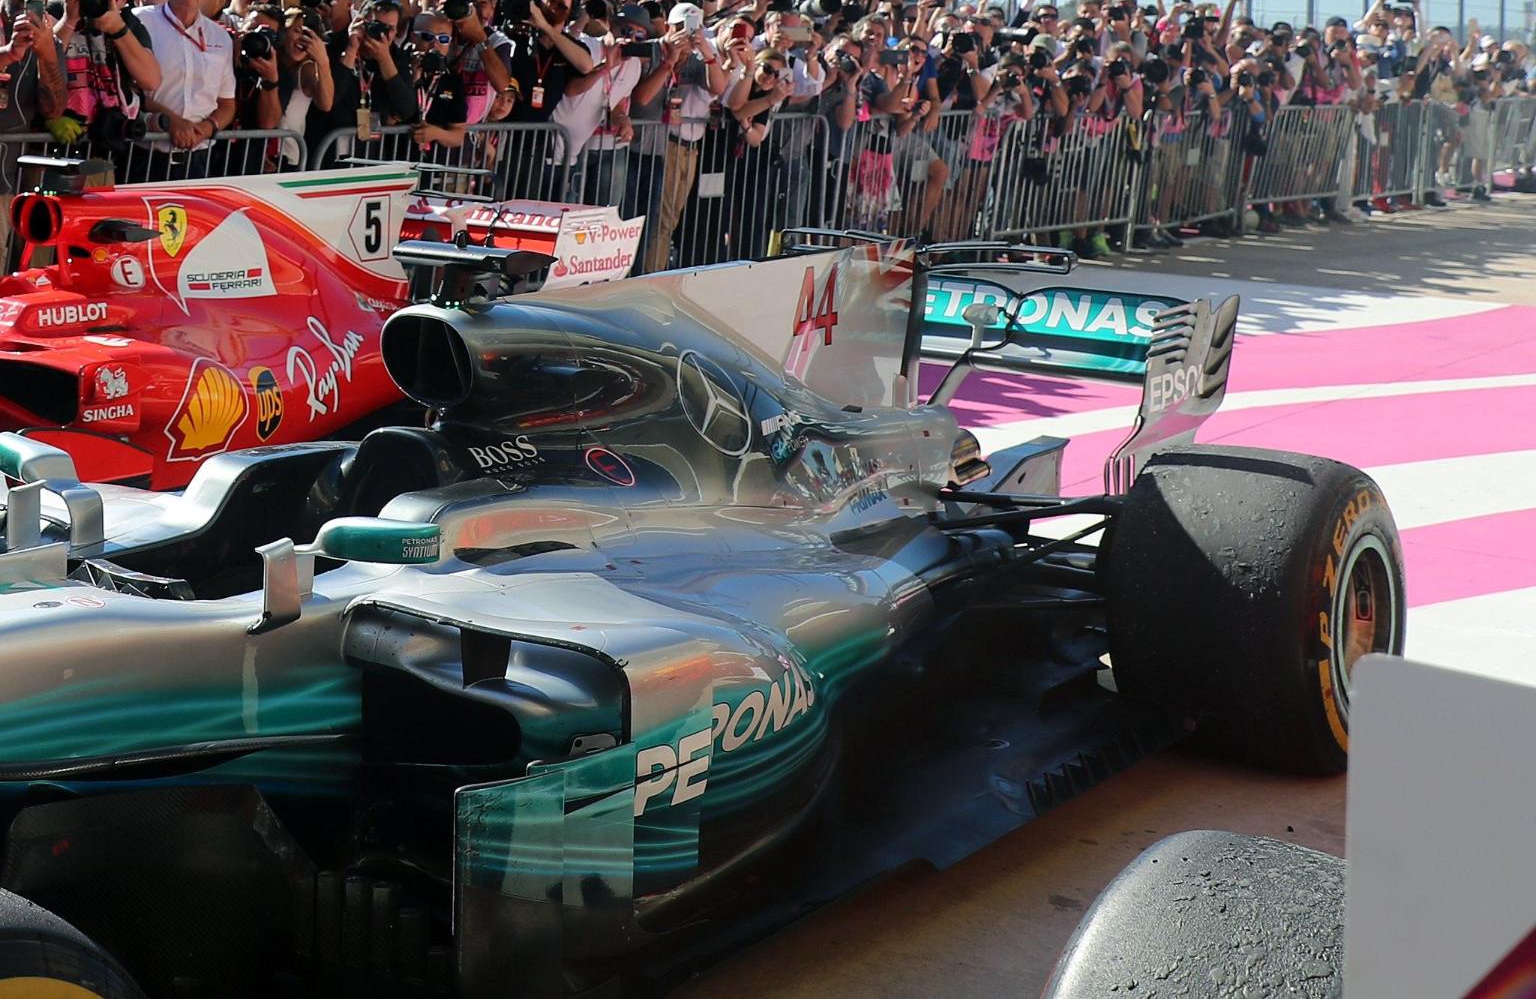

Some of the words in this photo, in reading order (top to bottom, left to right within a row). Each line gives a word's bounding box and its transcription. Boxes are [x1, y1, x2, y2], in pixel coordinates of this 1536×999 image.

[364, 202, 382, 254] 5
[590, 224, 641, 244] V-Power
[120, 259, 139, 285] E
[186, 269, 246, 282] SCUDERIA
[569, 250, 633, 276] Santander
[212, 279, 262, 293] FERRARI
[38, 303, 108, 327] HUBLOT
[792, 261, 838, 352] 44
[924, 279, 1166, 337] ETRONAS
[82, 404, 134, 423] SINGHA
[258, 386, 283, 432] ups
[468, 435, 539, 469] BOSS
[401, 536, 438, 545] PETRONAS
[1322, 489, 1371, 598] ZERO
